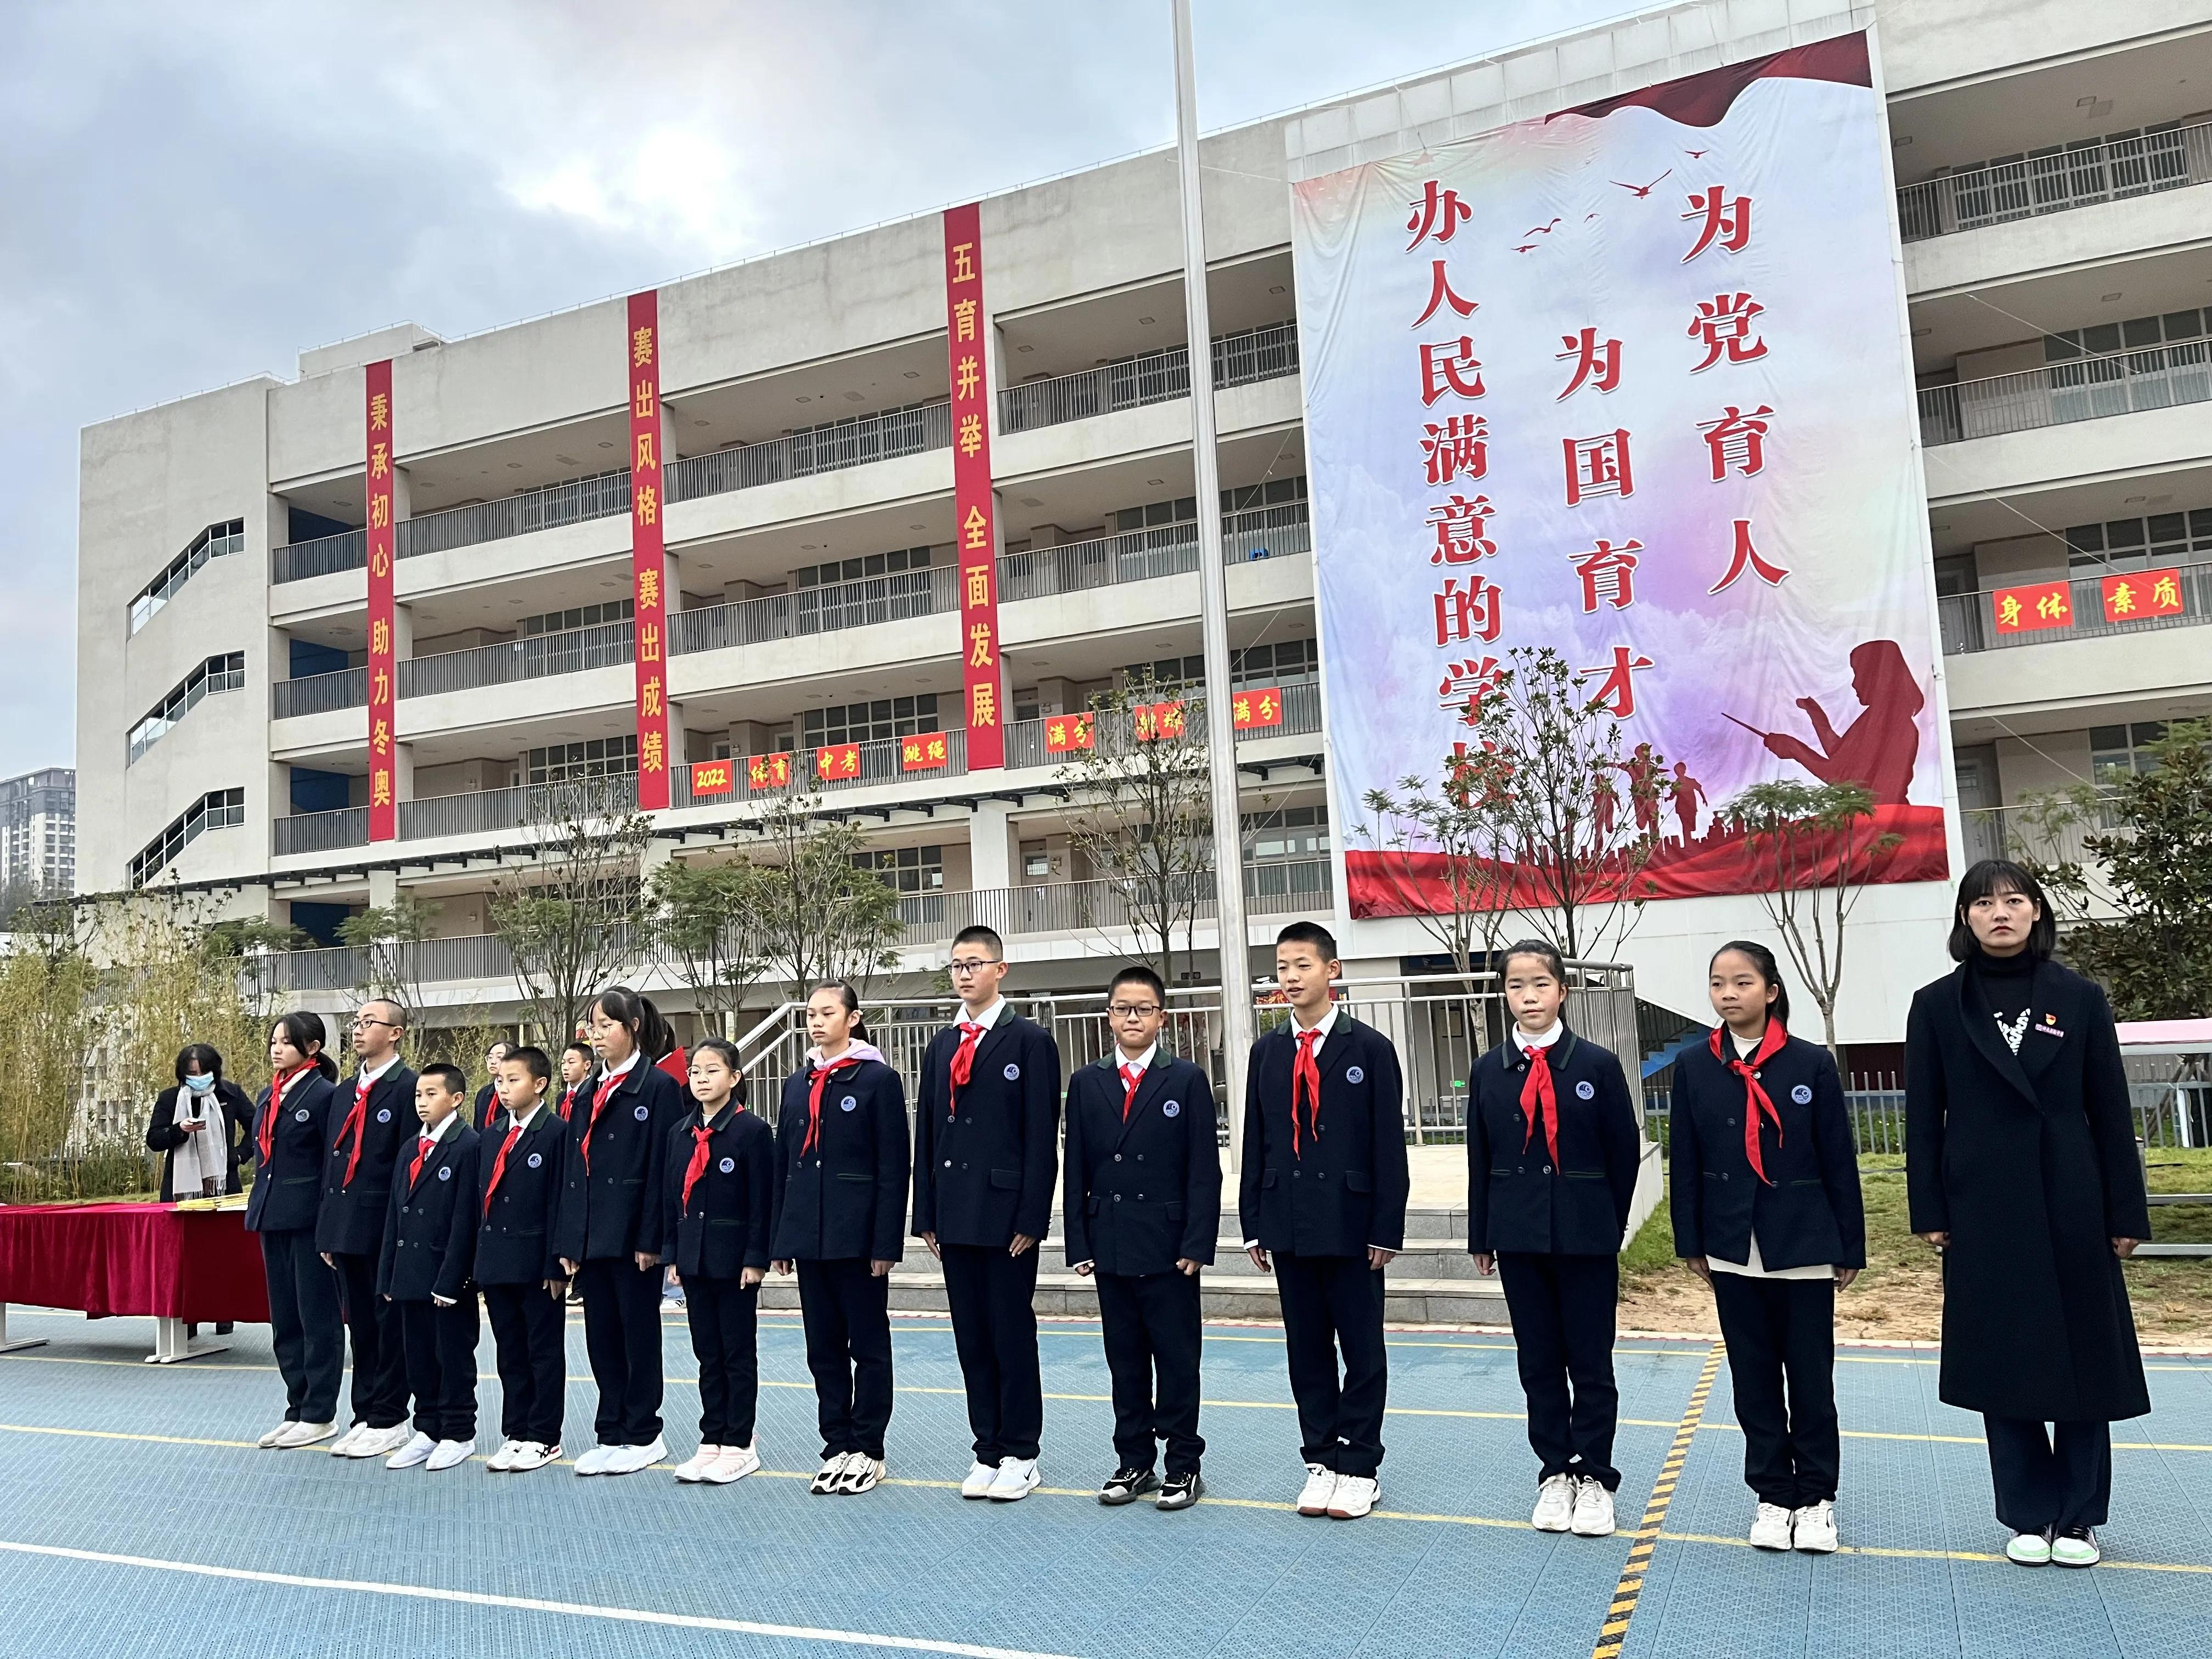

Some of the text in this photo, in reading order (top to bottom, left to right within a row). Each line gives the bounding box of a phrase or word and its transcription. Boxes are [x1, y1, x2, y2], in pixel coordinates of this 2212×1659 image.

[634, 327, 663, 773] 赛出风格 赛出成绩
[952, 242, 995, 727] 五育并举 全面发展
[1556, 327, 1654, 719] 为国育才
[1681, 185, 1790, 595] 为党育人
[370, 394, 391, 807] 秉承初心 助力冬奥
[697, 769, 727, 788] 2022
[819, 751, 857, 775] 中考
[903, 740, 946, 764] 跳绳
[1233, 695, 1278, 723] 满分
[1999, 577, 2179, 627] 身体 素质
